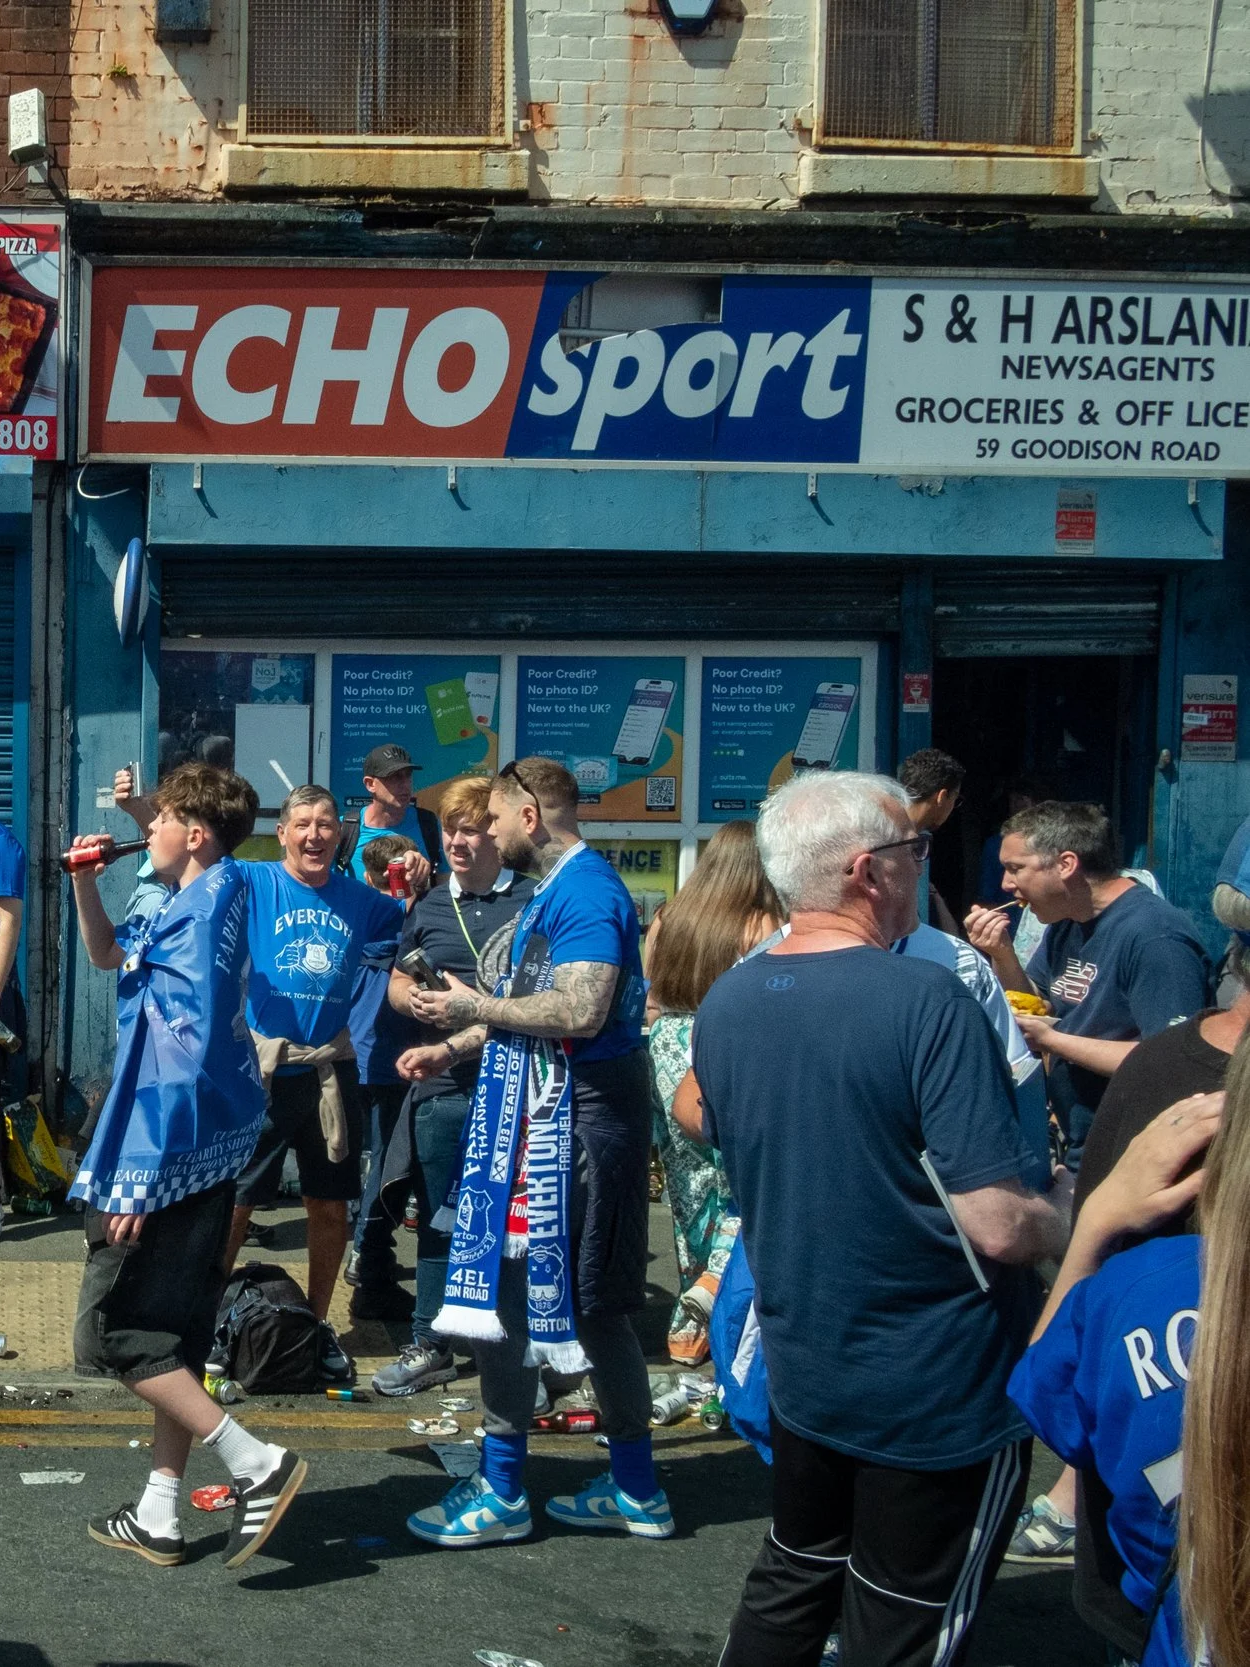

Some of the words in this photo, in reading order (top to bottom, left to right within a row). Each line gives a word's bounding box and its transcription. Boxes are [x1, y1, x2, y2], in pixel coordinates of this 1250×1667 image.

[903, 293, 925, 344] S
[945, 294, 978, 344] &
[1000, 295, 1034, 344] H
[1051, 295, 1250, 347] ARSLANI
[1001, 354, 1215, 382] NEWSAGENTS
[105, 304, 511, 428] ECHO
[528, 309, 862, 452] sport
[895, 396, 1064, 425] GROCERIES
[1078, 400, 1100, 426] &
[1115, 400, 1174, 427] OFF
[1186, 401, 1249, 428] LICE
[976, 438, 1000, 459] 59
[1011, 439, 1142, 461] GOODISON
[1150, 441, 1221, 462] ROAD
[1058, 513, 1093, 523] Alarm
[343, 670, 369, 680] Poor
[371, 670, 413, 680] Credit?
[528, 669, 552, 679] Poor
[555, 669, 597, 679] Credit?
[712, 669, 738, 678] Poor
[740, 668, 782, 678] Credit?
[343, 686, 358, 696] No
[361, 686, 395, 697] photo
[397, 686, 414, 696] ID?
[528, 685, 543, 695] No
[545, 685, 578, 696] photo
[581, 685, 598, 695] ID?
[712, 685, 727, 694] No
[730, 684, 763, 696] photo
[765, 685, 783, 694] ID?
[1186, 692, 1235, 701] verisure
[343, 704, 368, 714] New
[370, 705, 381, 714] to
[384, 704, 403, 714] the
[405, 704, 427, 714] UK?
[527, 703, 552, 713] New
[554, 704, 566, 713] to
[569, 703, 588, 713] the
[590, 703, 611, 713] UK?
[712, 703, 736, 712] New
[739, 704, 750, 712] to
[753, 703, 771, 712] the
[774, 703, 796, 712] UK?
[206, 873, 234, 894] 1892
[493, 1043, 509, 1080] 1892
[510, 1051, 521, 1070] OF
[503, 1075, 518, 1125] YEARS
[476, 1084, 488, 1159] THANKS
[498, 1129, 511, 1148] 133
[559, 1101, 571, 1172] FAREWELL
[177, 1143, 226, 1164] CHARITY
[105, 1169, 164, 1183] LEAGUE
[163, 1154, 229, 1180] CHAMPIONS
[528, 1121, 559, 1239] EVERTON
[451, 1268, 490, 1288] 4EL
[462, 1286, 489, 1301] ROAD
[528, 1317, 570, 1333] VERTON
